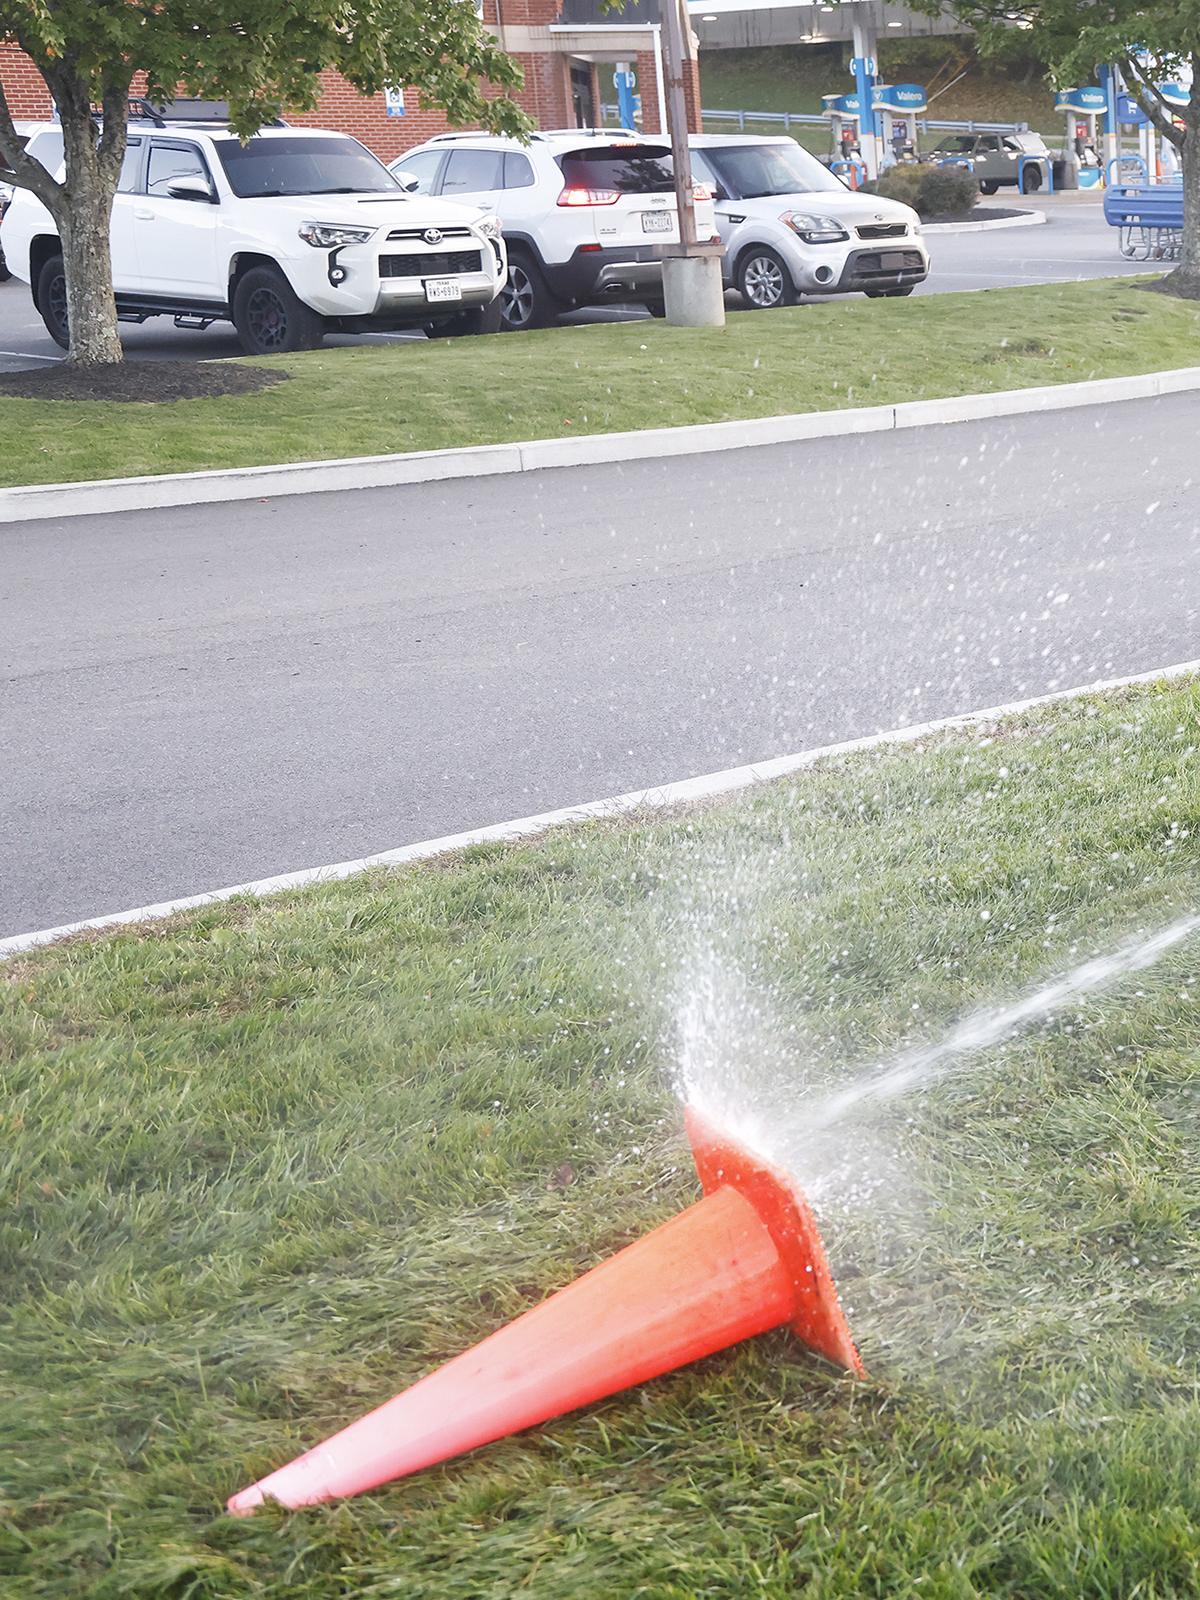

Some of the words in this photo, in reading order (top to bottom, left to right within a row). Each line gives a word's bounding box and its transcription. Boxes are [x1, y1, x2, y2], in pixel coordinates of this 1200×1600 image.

[896, 91, 922, 101] Valero
[1082, 93, 1104, 103] Valero
[845, 100, 859, 108] Val
